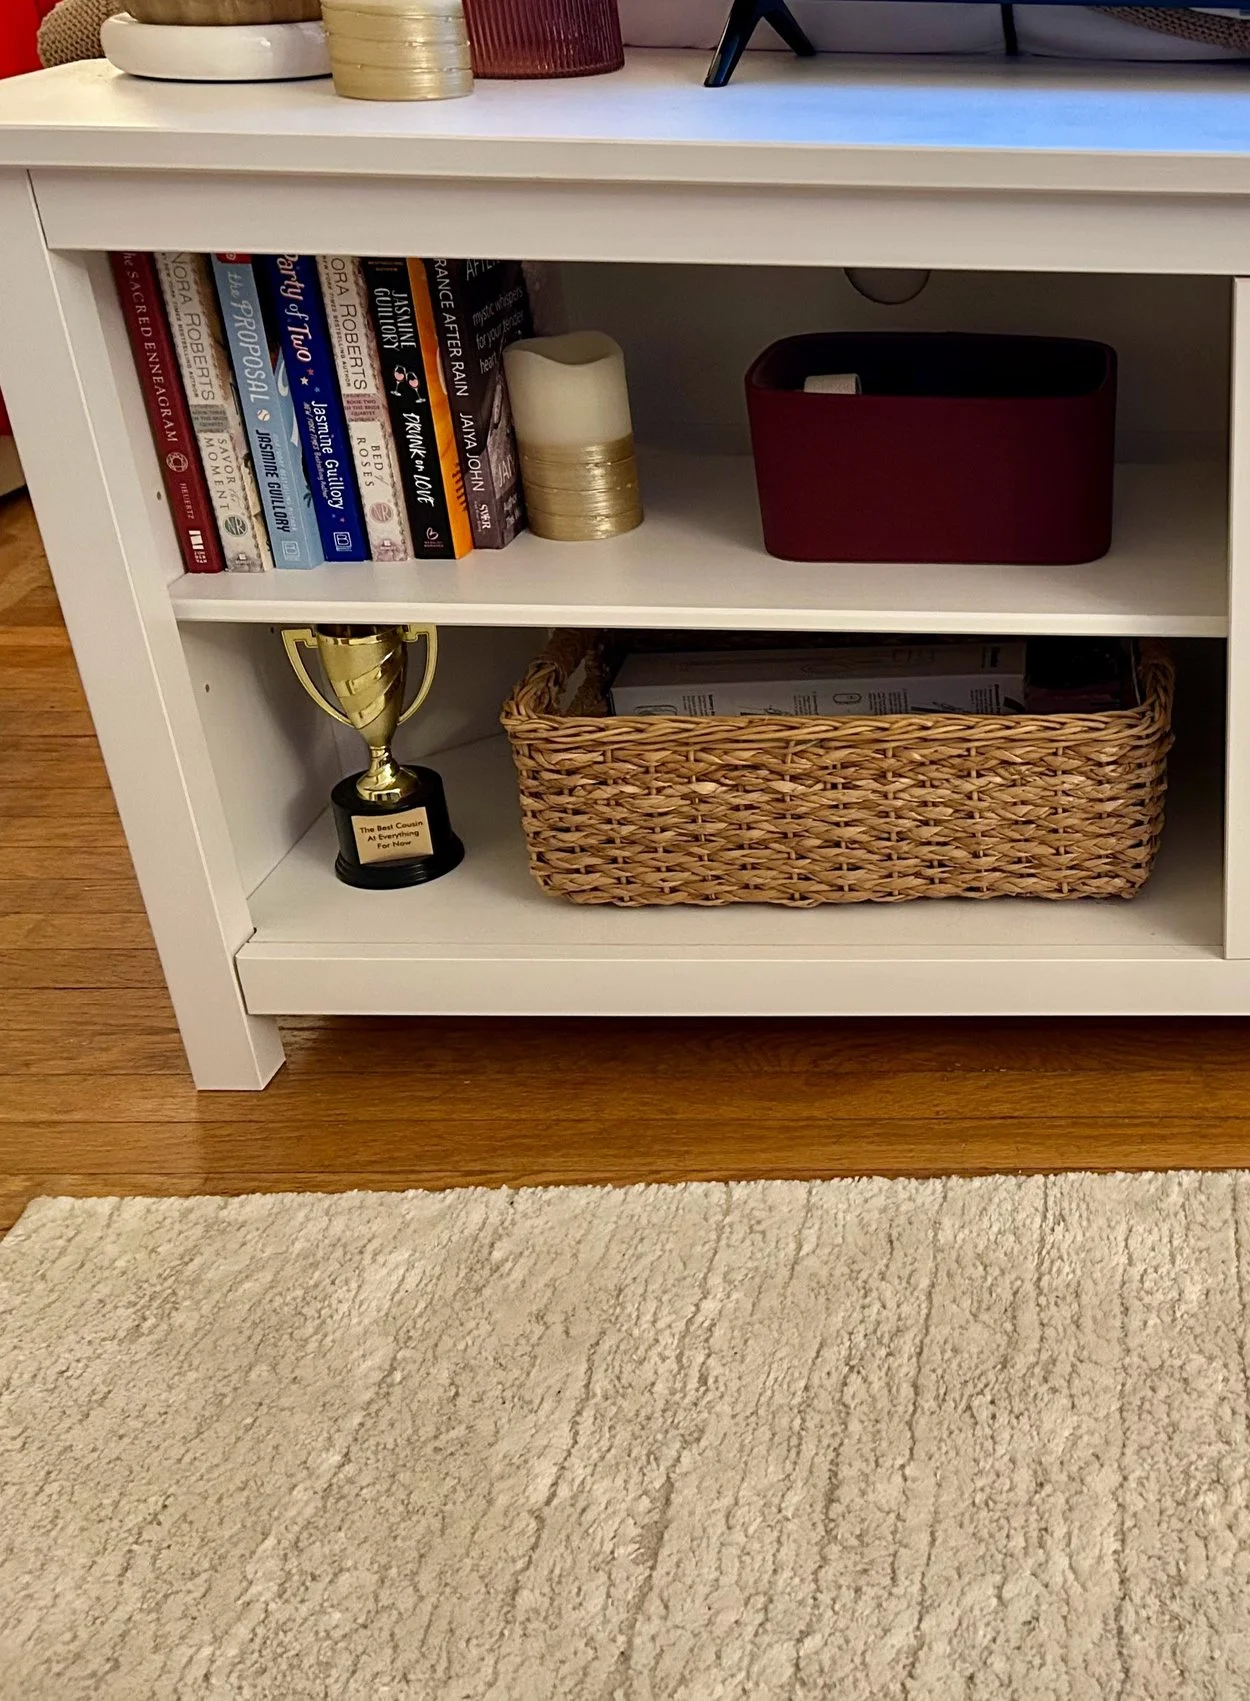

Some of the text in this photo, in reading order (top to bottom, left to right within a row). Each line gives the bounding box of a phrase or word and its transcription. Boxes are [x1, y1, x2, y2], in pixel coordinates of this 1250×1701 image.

[285, 302, 310, 322] of
[329, 292, 338, 313] TIMES
[330, 257, 368, 390] ORA ROBERTS
[374, 287, 401, 352] GUILLORY
[391, 289, 417, 349] JASMINE
[432, 258, 470, 397] RANCE AFTER RAIN
[123, 251, 179, 443] he SACRED ENNEAGRAM
[177, 323, 193, 370] BESTSELLING
[188, 371, 200, 398] AUTHOR
[183, 312, 216, 401] ROBERTS
[226, 271, 271, 404] the PROPOSAL
[287, 322, 312, 363] Two
[332, 315, 346, 359] BESTSELLING
[342, 360, 352, 388] AUTHOR
[256, 429, 280, 479] JASMINE
[311, 400, 346, 510] Jasmine Guillory
[459, 412, 478, 450] JAIYA
[204, 436, 231, 511] MOMENT
[217, 437, 236, 484] SAVOR
[356, 436, 375, 487] ROSES
[371, 445, 385, 472] BED
[402, 412, 427, 460] DRUNK
[415, 476, 435, 507] LOVE
[466, 452, 486, 492] JOHN
[179, 482, 195, 520] HEUERTZ
[267, 482, 292, 533] GUILLORY
[376, 824, 394, 832] Best
[395, 820, 423, 830] Cousin
[378, 830, 420, 841] Everything
[392, 840, 412, 848] Now
